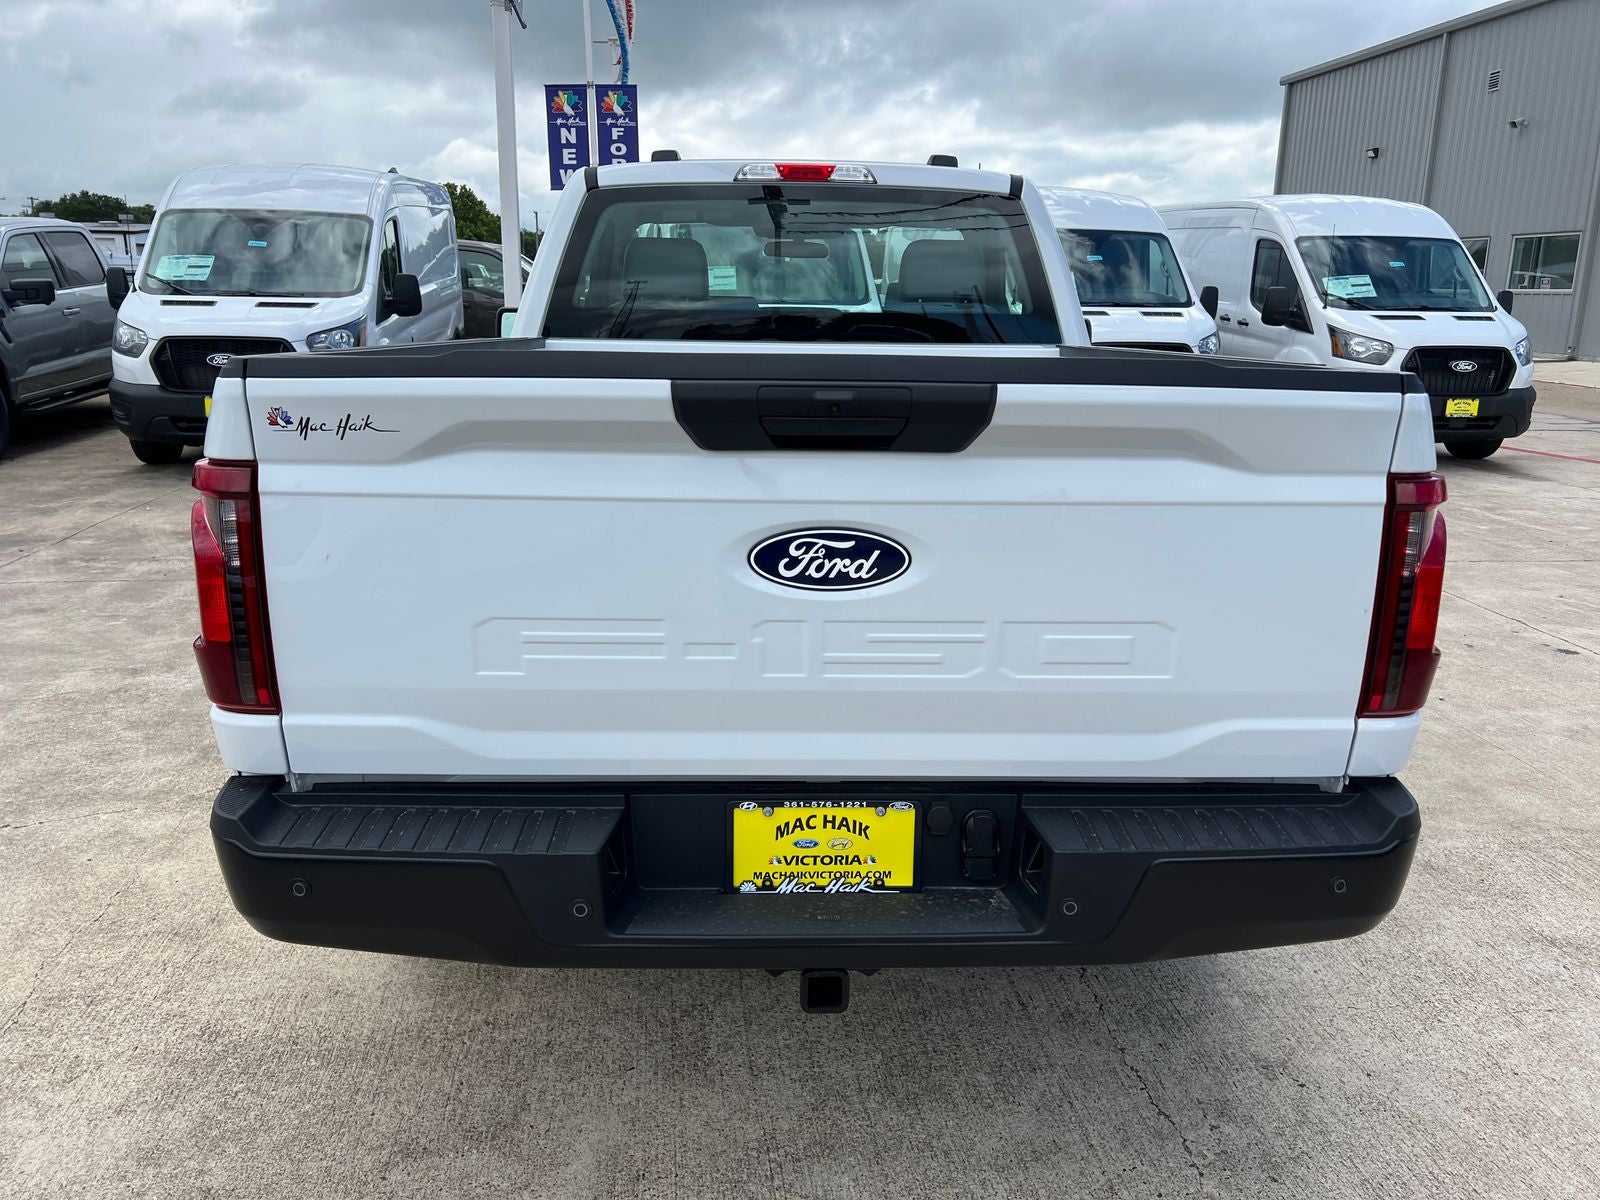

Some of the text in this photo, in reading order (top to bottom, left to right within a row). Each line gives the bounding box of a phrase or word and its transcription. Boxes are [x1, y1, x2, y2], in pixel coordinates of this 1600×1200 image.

[295, 413, 386, 441] Mac Haik
[778, 538, 881, 579] Ford
[472, 617, 1178, 680] F-150
[775, 814, 871, 841] MAC HAIK
[783, 855, 863, 866] VICTORIA
[753, 870, 892, 880] MACHAIKVICTORIA.COM
[775, 877, 876, 894] Mac Haik
